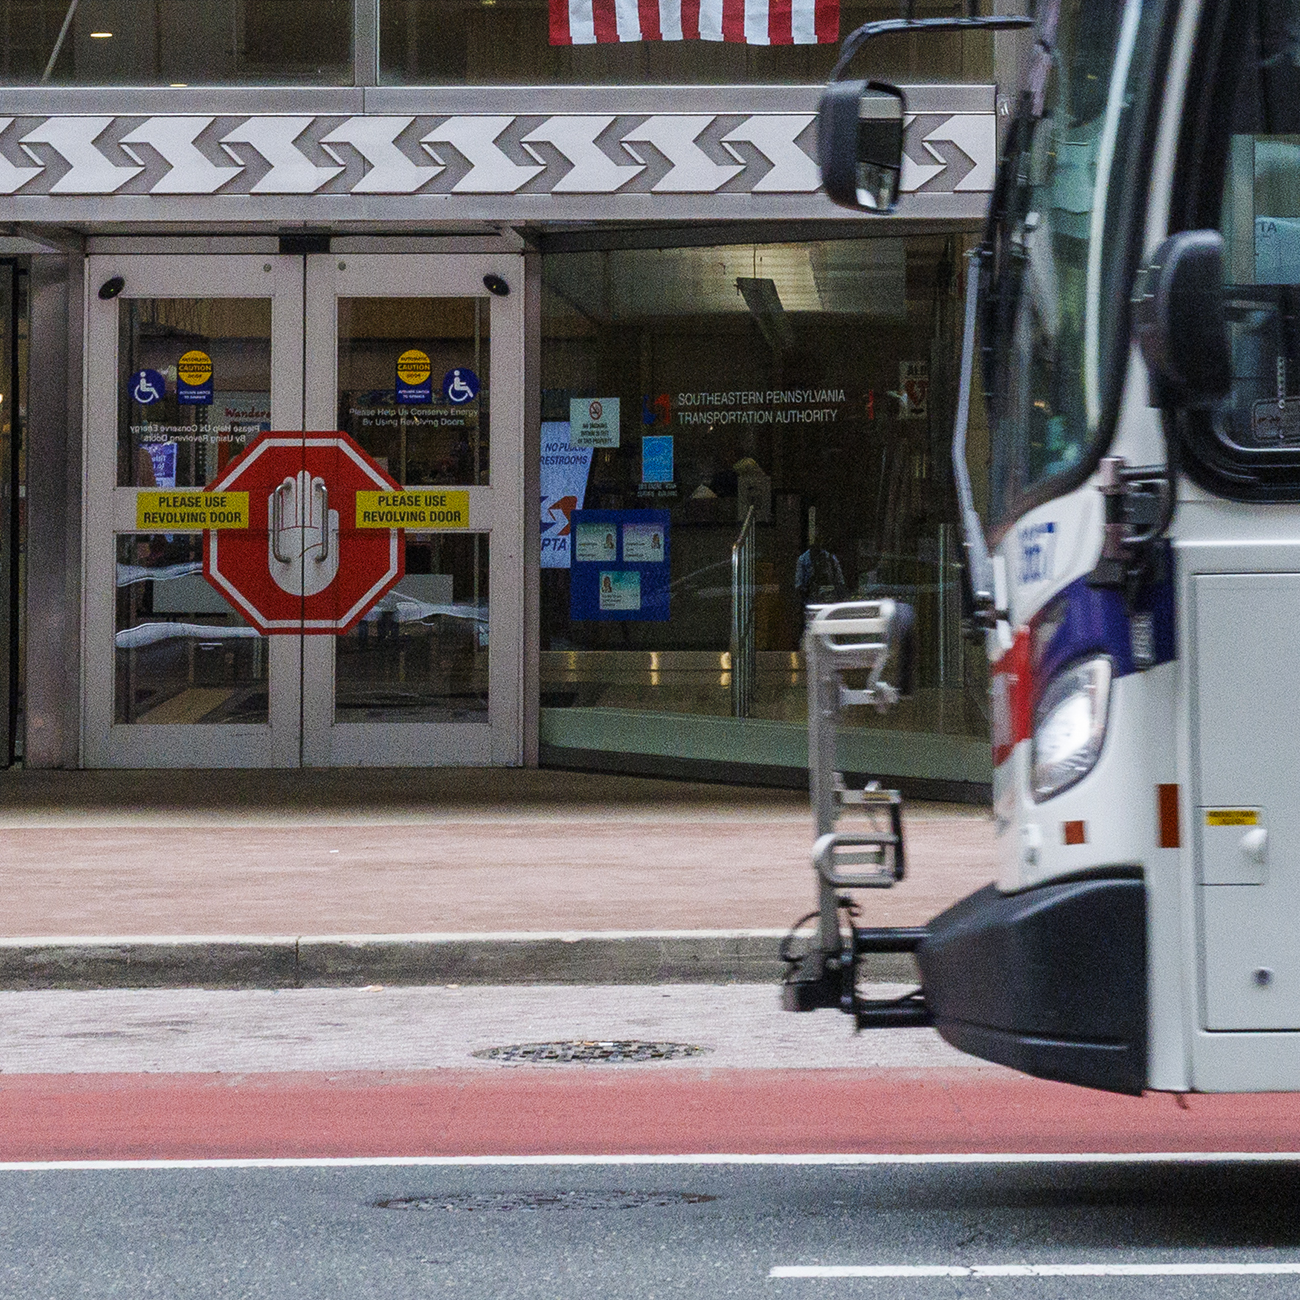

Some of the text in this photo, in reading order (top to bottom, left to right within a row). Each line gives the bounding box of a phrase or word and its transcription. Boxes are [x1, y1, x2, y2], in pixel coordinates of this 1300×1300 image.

[677, 389, 846, 406] SOUTHEASTERN PENNSYLVANIA
[349, 408, 478, 418] Please Help Us Conserve Energy
[677, 409, 838, 425] TRANSPORTATION AUTHORITY
[362, 418, 464, 428] By Using Revolving Doors
[544, 443, 558, 452] NO
[540, 455, 588, 466] RESTROOMS
[159, 496, 227, 508] PLEASE USE
[378, 495, 446, 507] PLEASE USE
[144, 511, 241, 523] REVOLVING DOOR
[363, 511, 461, 522] REVOLVING DOOR
[541, 538, 566, 551] PTA
